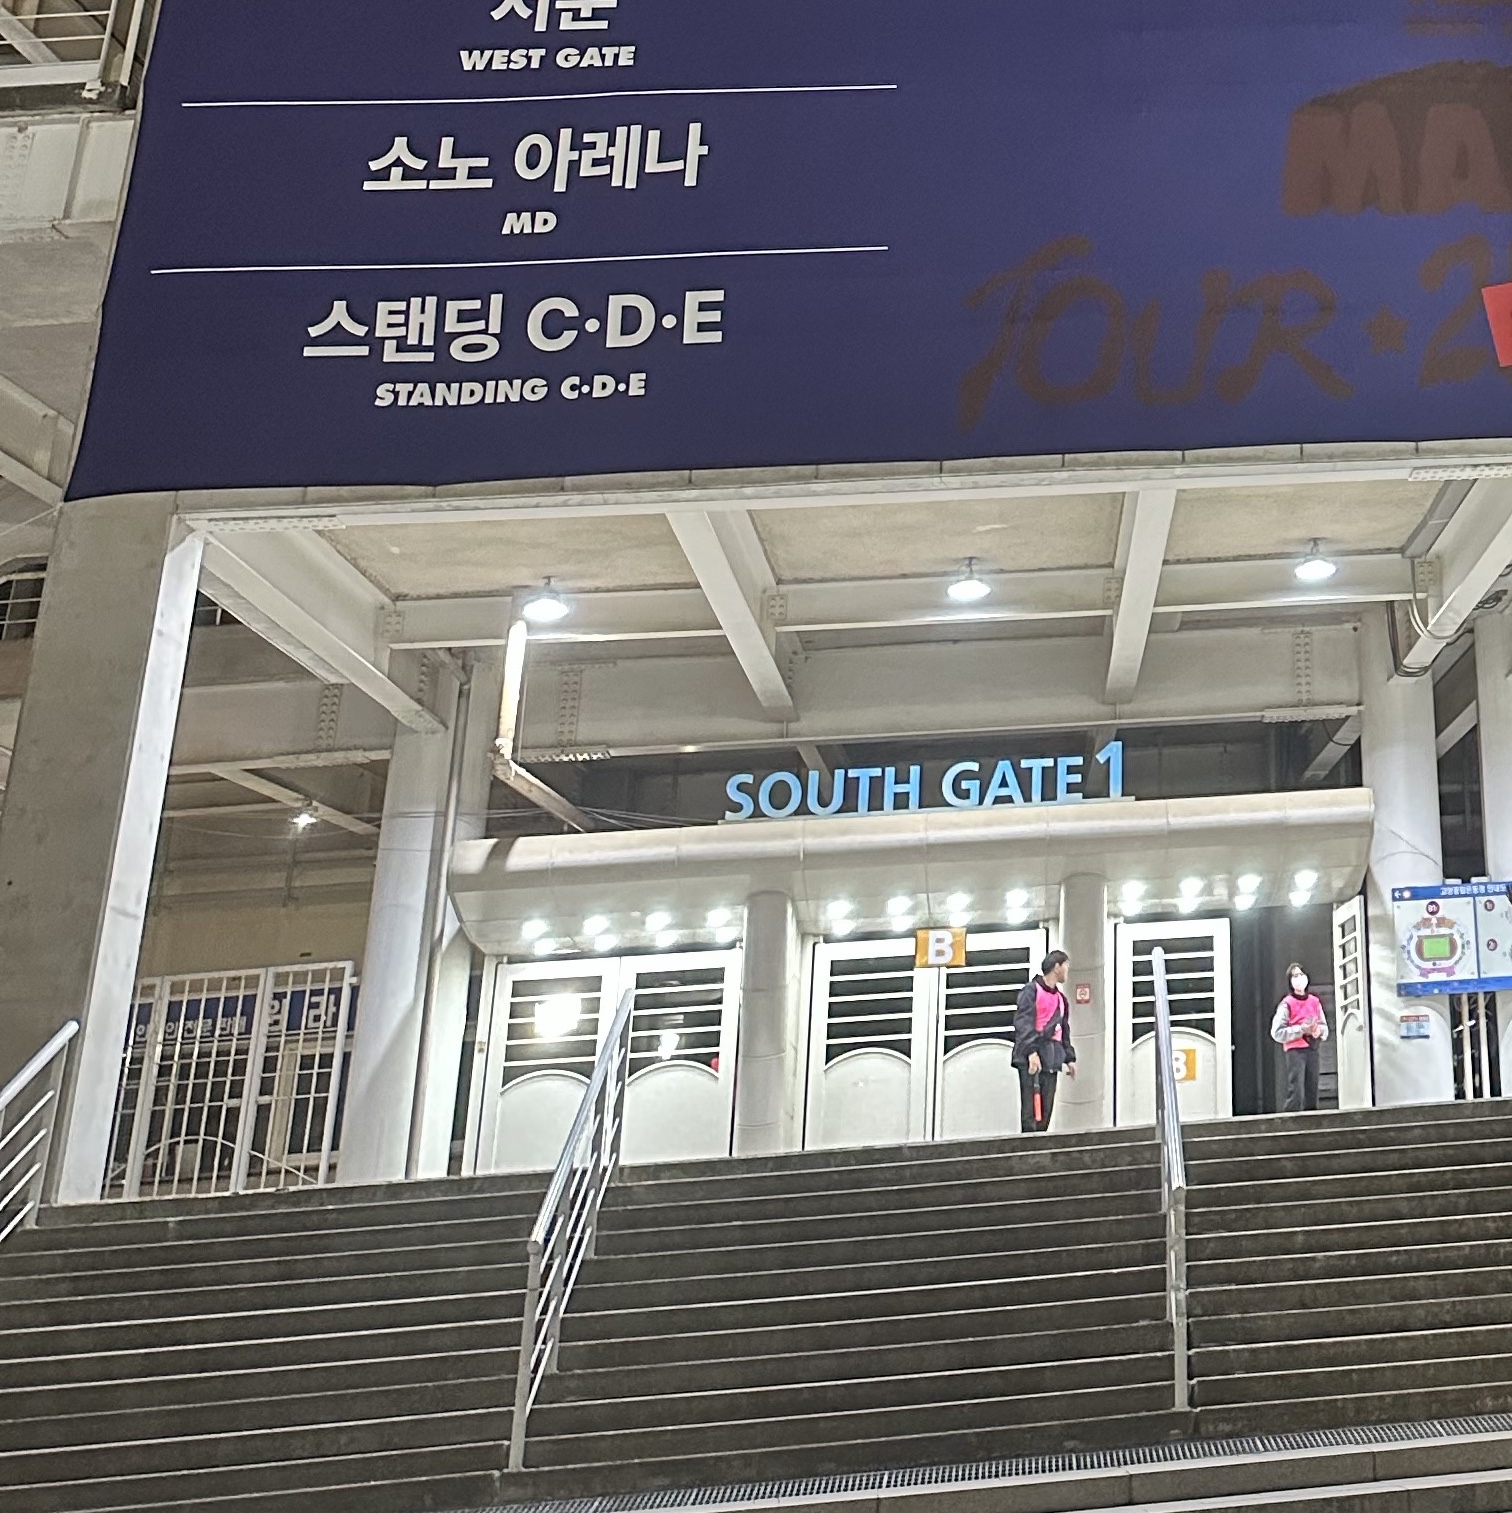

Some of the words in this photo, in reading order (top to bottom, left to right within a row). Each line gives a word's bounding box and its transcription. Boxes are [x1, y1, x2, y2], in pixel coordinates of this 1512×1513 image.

[459, 48, 546, 72] WEST
[555, 45, 636, 70] GATE
[362, 136, 494, 192] 소노
[513, 122, 710, 193] 아레나
[501, 211, 558, 236] MD
[302, 293, 504, 364] 스탠딩
[956, 234, 1356, 435] TOUR
[374, 377, 549, 408] STANDING
[724, 764, 922, 821] SOUTH
[928, 930, 953, 965] B
